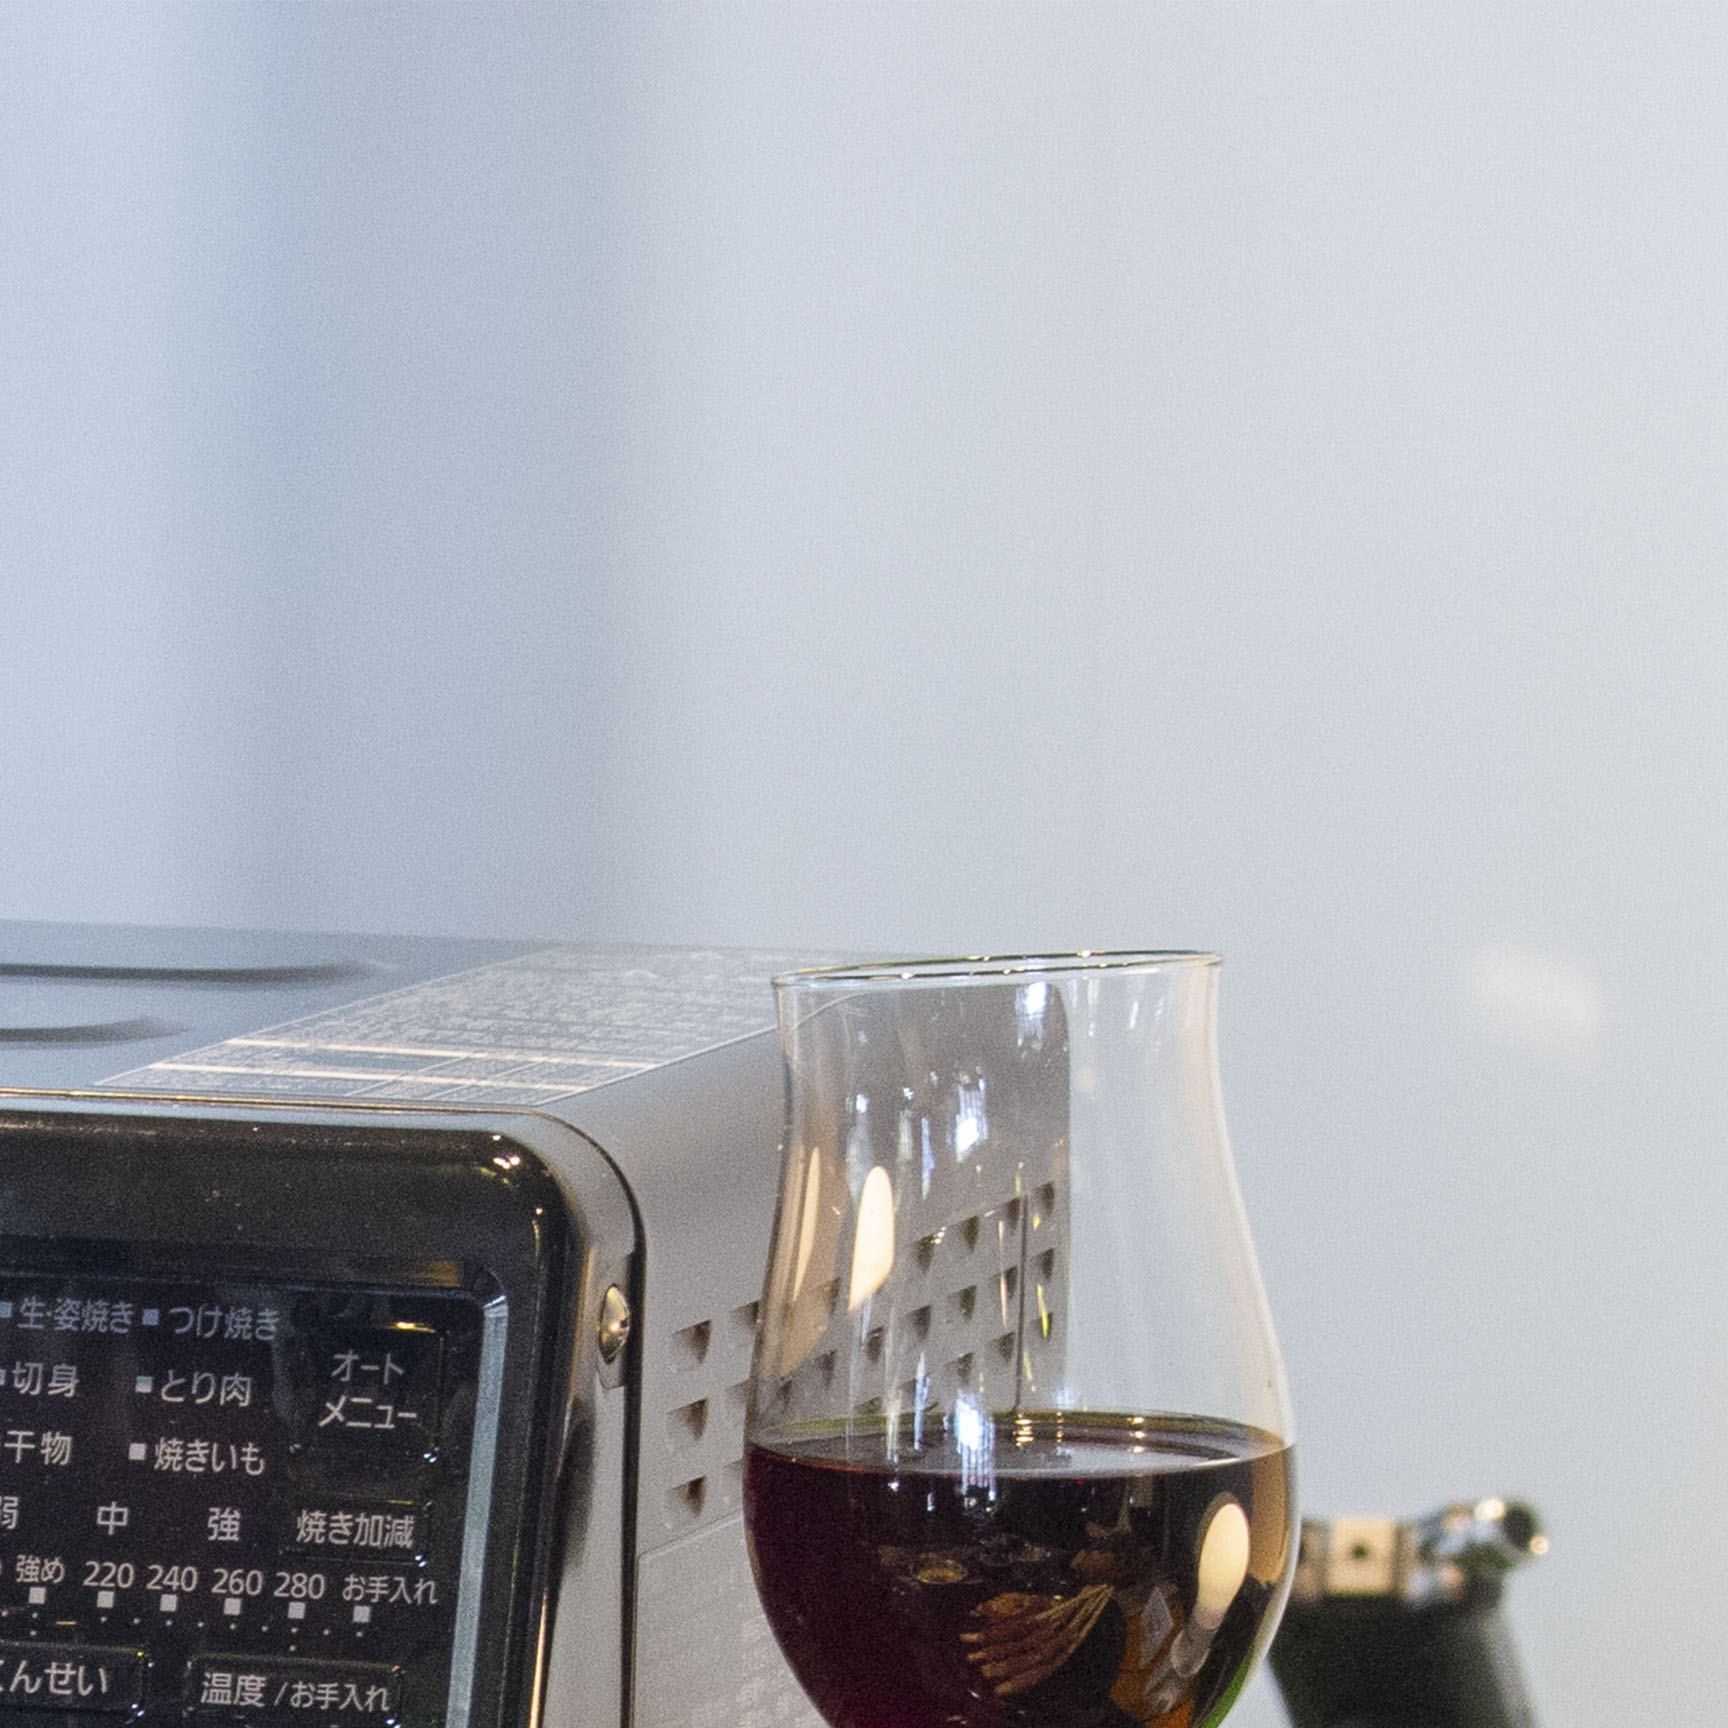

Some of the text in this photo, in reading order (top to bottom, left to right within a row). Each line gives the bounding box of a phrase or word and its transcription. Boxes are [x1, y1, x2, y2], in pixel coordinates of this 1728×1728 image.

[168, 1303, 280, 1341] つけ焼き
[12, 1360, 252, 1407] 切身 とり肉
[331, 1351, 405, 1384] オート
[318, 1397, 419, 1430] メニュー
[3, 1429, 266, 1476] 干物 焼きいも
[96, 1500, 129, 1536] 中
[207, 1506, 241, 1542] 強
[295, 1509, 416, 1549] 焼き加減
[15, 1553, 65, 1584] 強め
[82, 1559, 135, 1589] 220
[145, 1563, 199, 1593] 240
[210, 1567, 264, 1596] 260
[272, 1570, 326, 1600] 280
[341, 1573, 439, 1606] お手入れ
